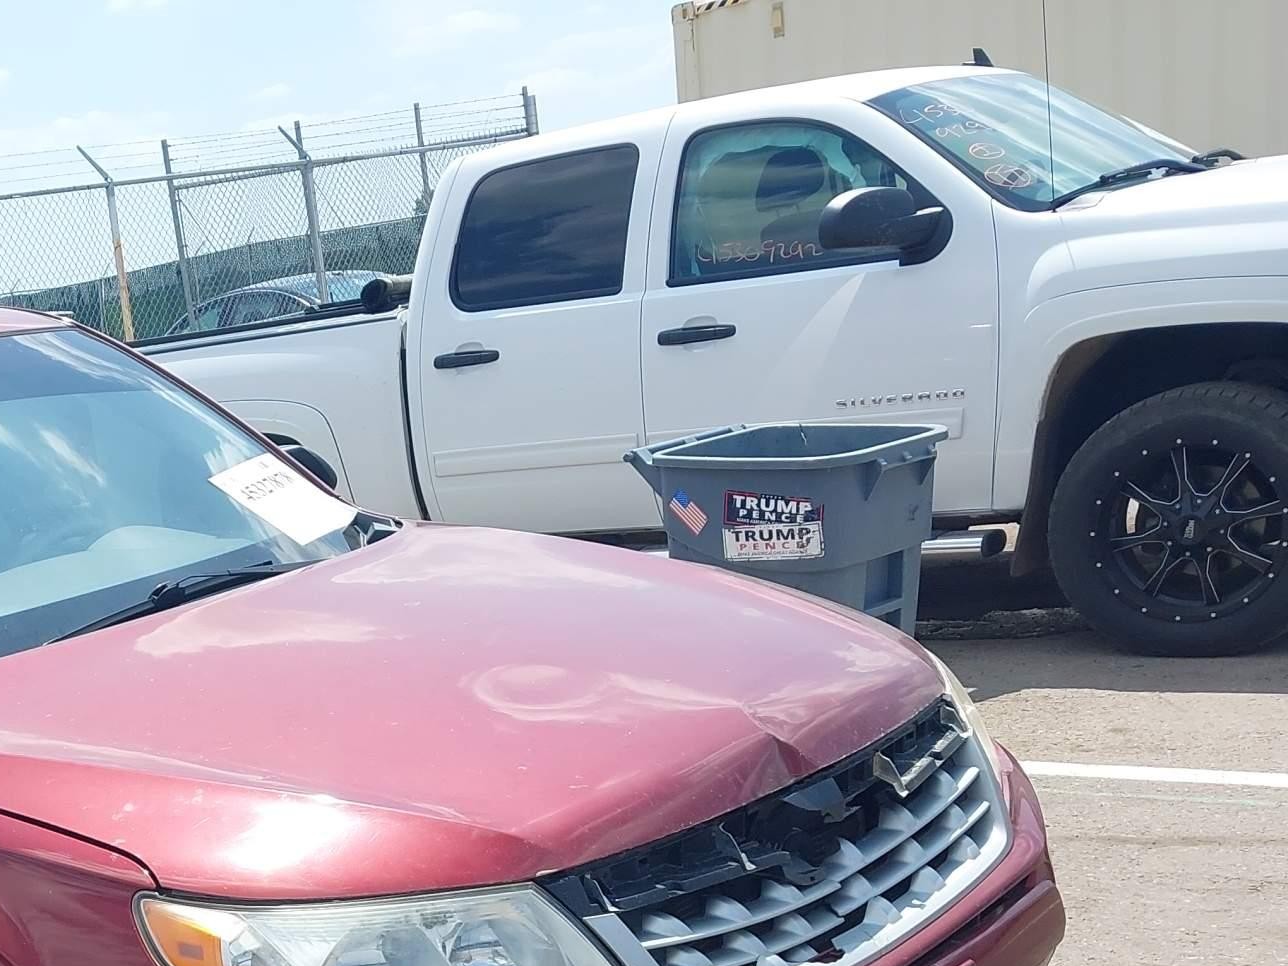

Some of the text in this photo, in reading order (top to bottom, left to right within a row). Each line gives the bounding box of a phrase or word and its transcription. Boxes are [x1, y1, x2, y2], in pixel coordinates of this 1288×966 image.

[835, 388, 965, 408] SILVERADO
[732, 494, 813, 514] TRUMP
[738, 508, 804, 523] PENCE
[732, 527, 812, 542] TRUMP
[739, 541, 806, 551] PENCE
